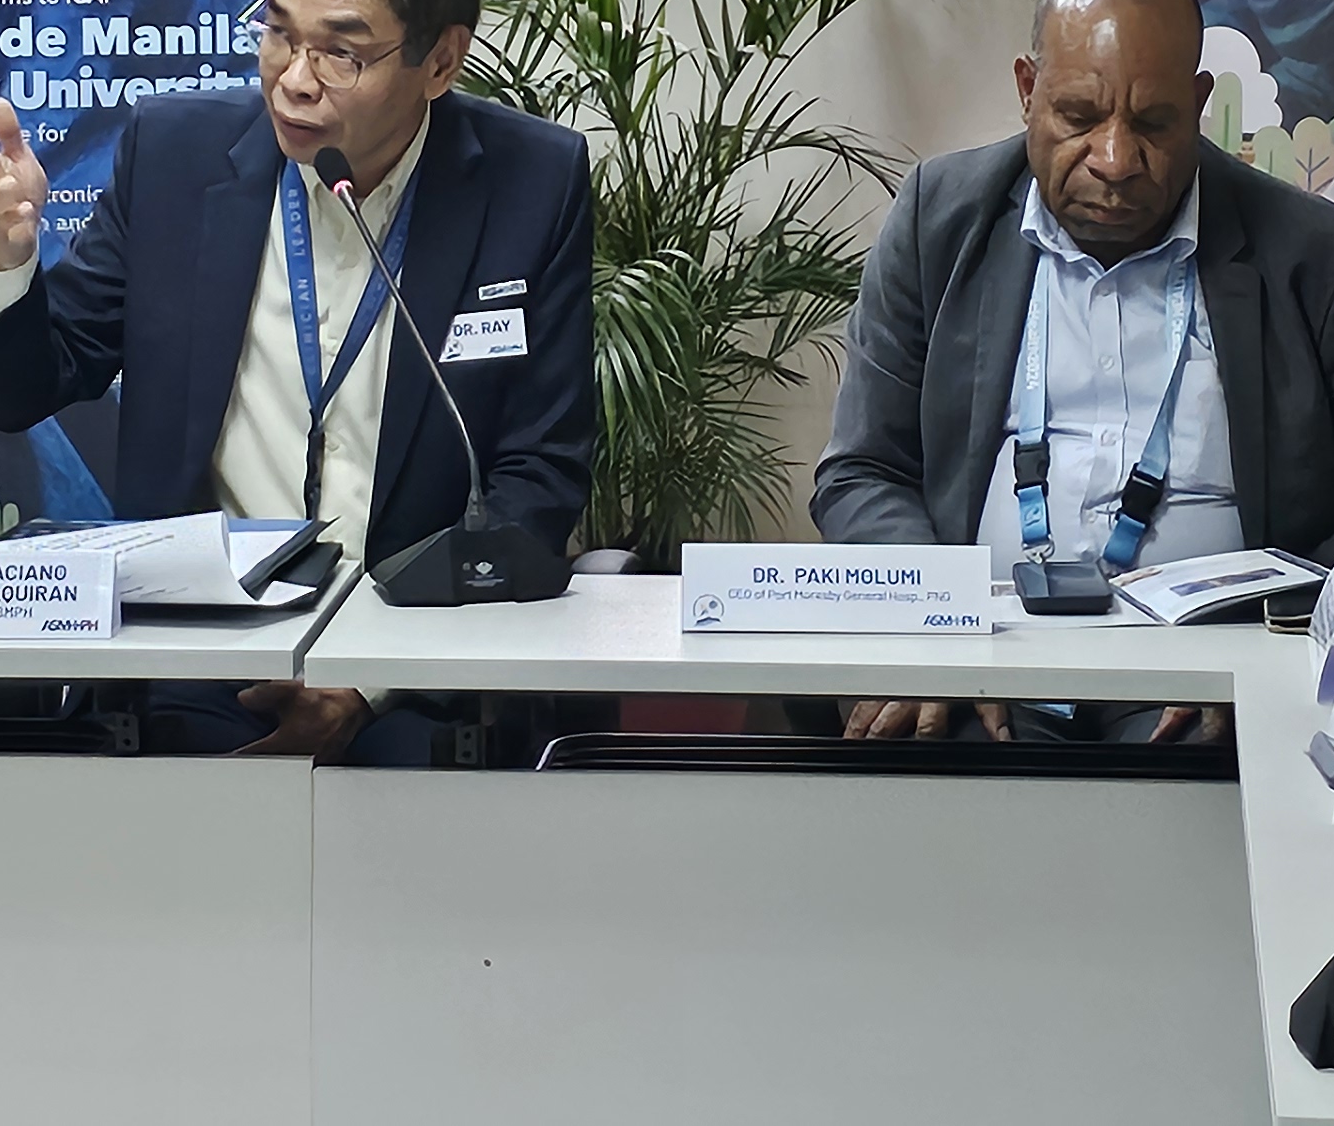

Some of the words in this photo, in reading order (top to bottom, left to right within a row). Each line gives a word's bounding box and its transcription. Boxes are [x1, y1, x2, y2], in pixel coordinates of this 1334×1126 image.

[81, 13, 261, 58] Manila
[36, 126, 68, 144] for
[454, 324, 478, 337] DR.
[481, 319, 510, 334] RAY
[753, 568, 784, 584] DR.
[795, 568, 839, 585] PAKI
[846, 569, 921, 585] MOLUMI
